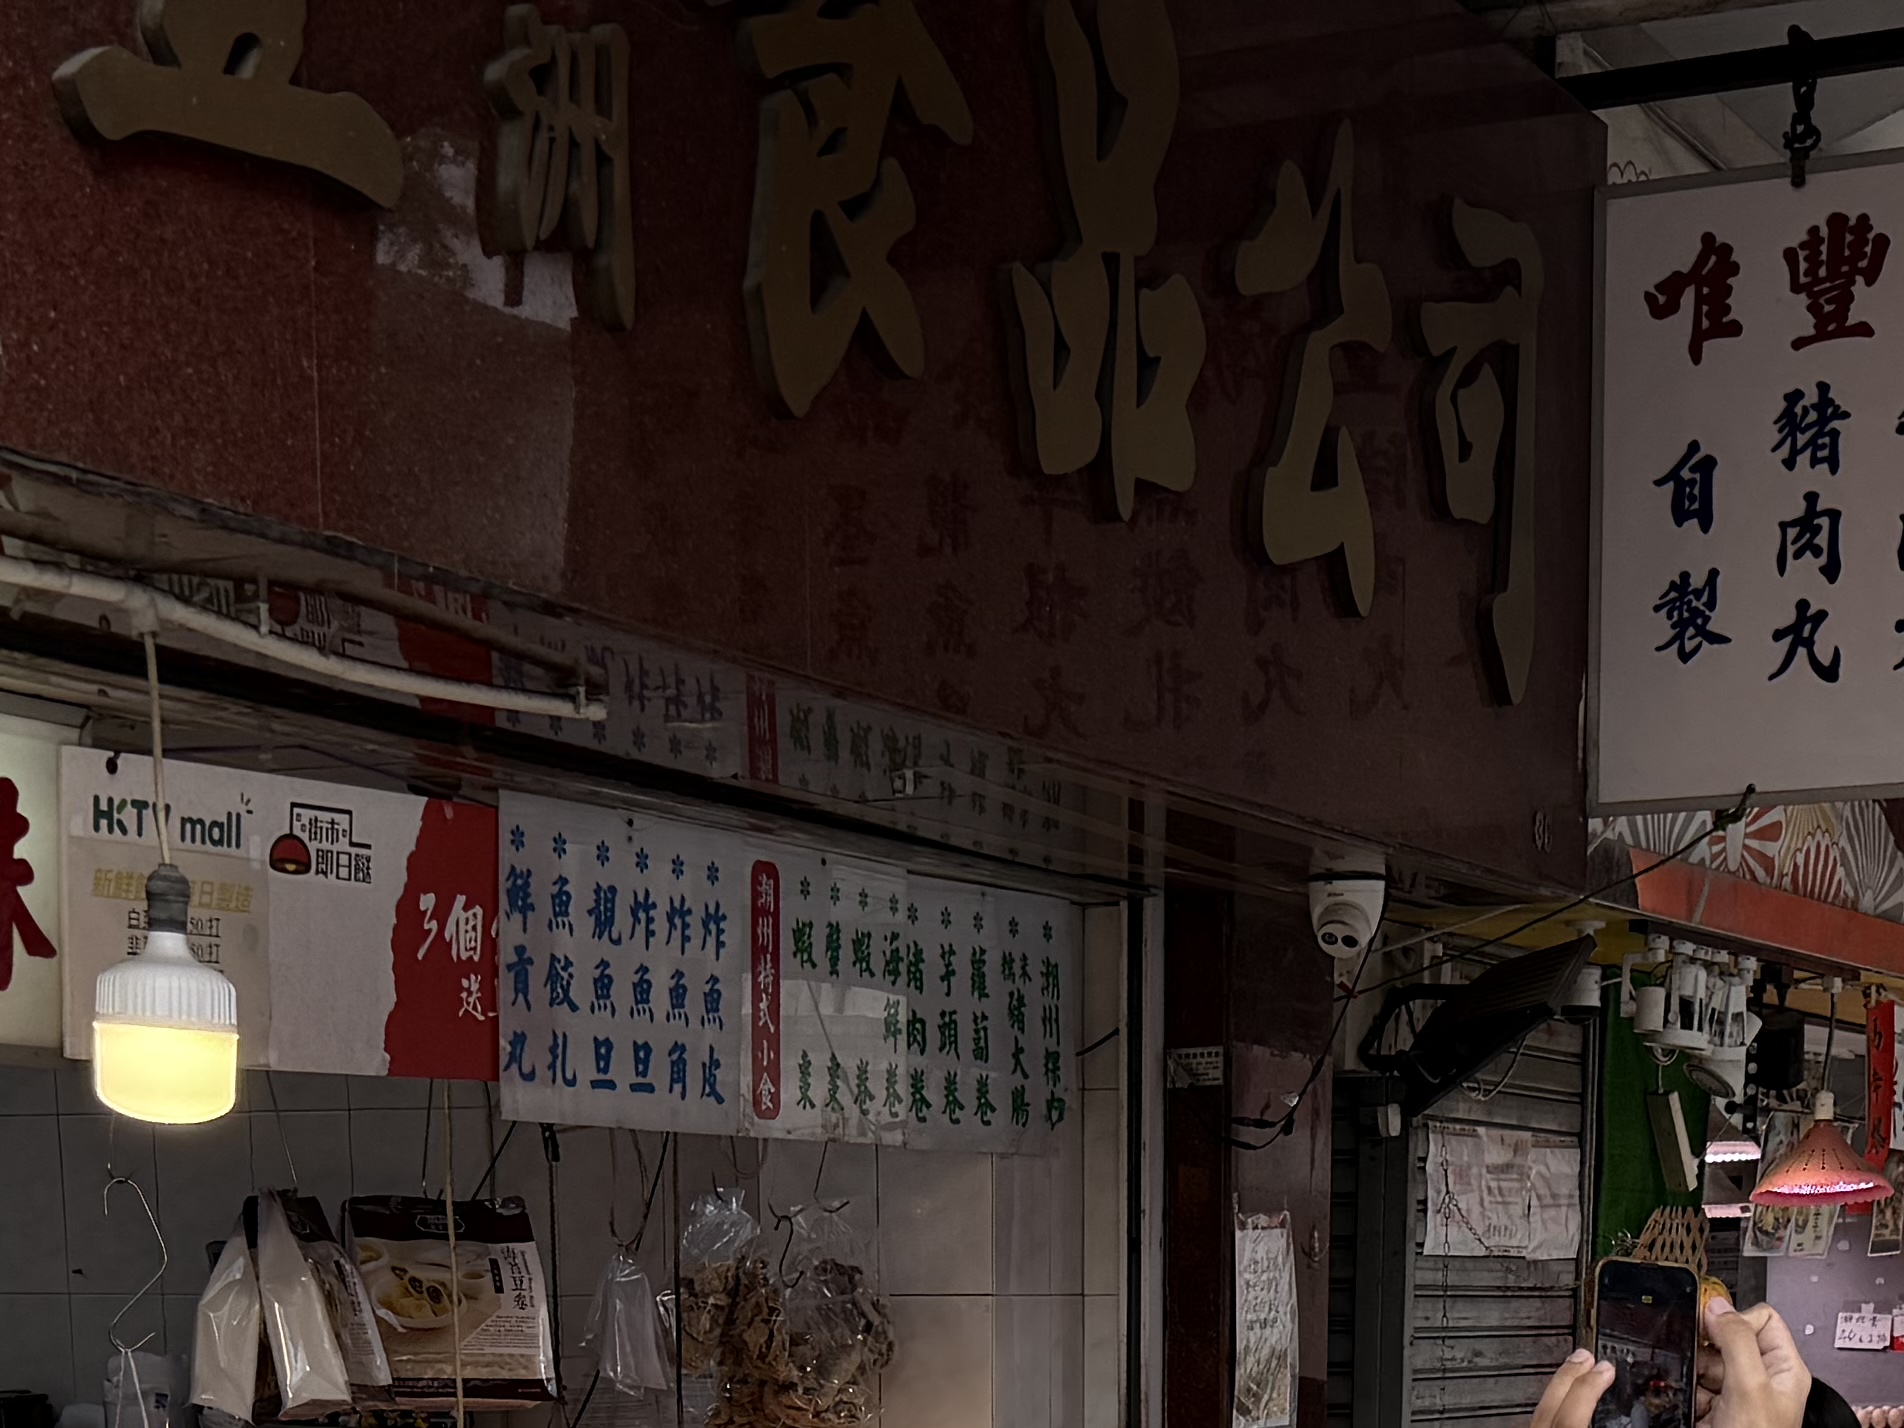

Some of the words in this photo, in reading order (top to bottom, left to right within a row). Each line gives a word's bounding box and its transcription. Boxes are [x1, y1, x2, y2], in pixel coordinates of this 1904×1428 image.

[1652, 440, 1734, 665] 自製
[1770, 381, 1845, 684] 豬肉丸
[179, 810, 242, 849] mall
[458, 974, 498, 1021] 送
[503, 864, 535, 1084] 鮮貢丸
[544, 876, 579, 1089] 魚餃扎
[586, 882, 622, 1092] 靚魚旦
[627, 889, 658, 1095] 炸魚旦
[664, 894, 694, 1101] 炸魚角
[699, 900, 726, 1105] 炸魚皮
[755, 873, 776, 1114] 潮州特式小食
